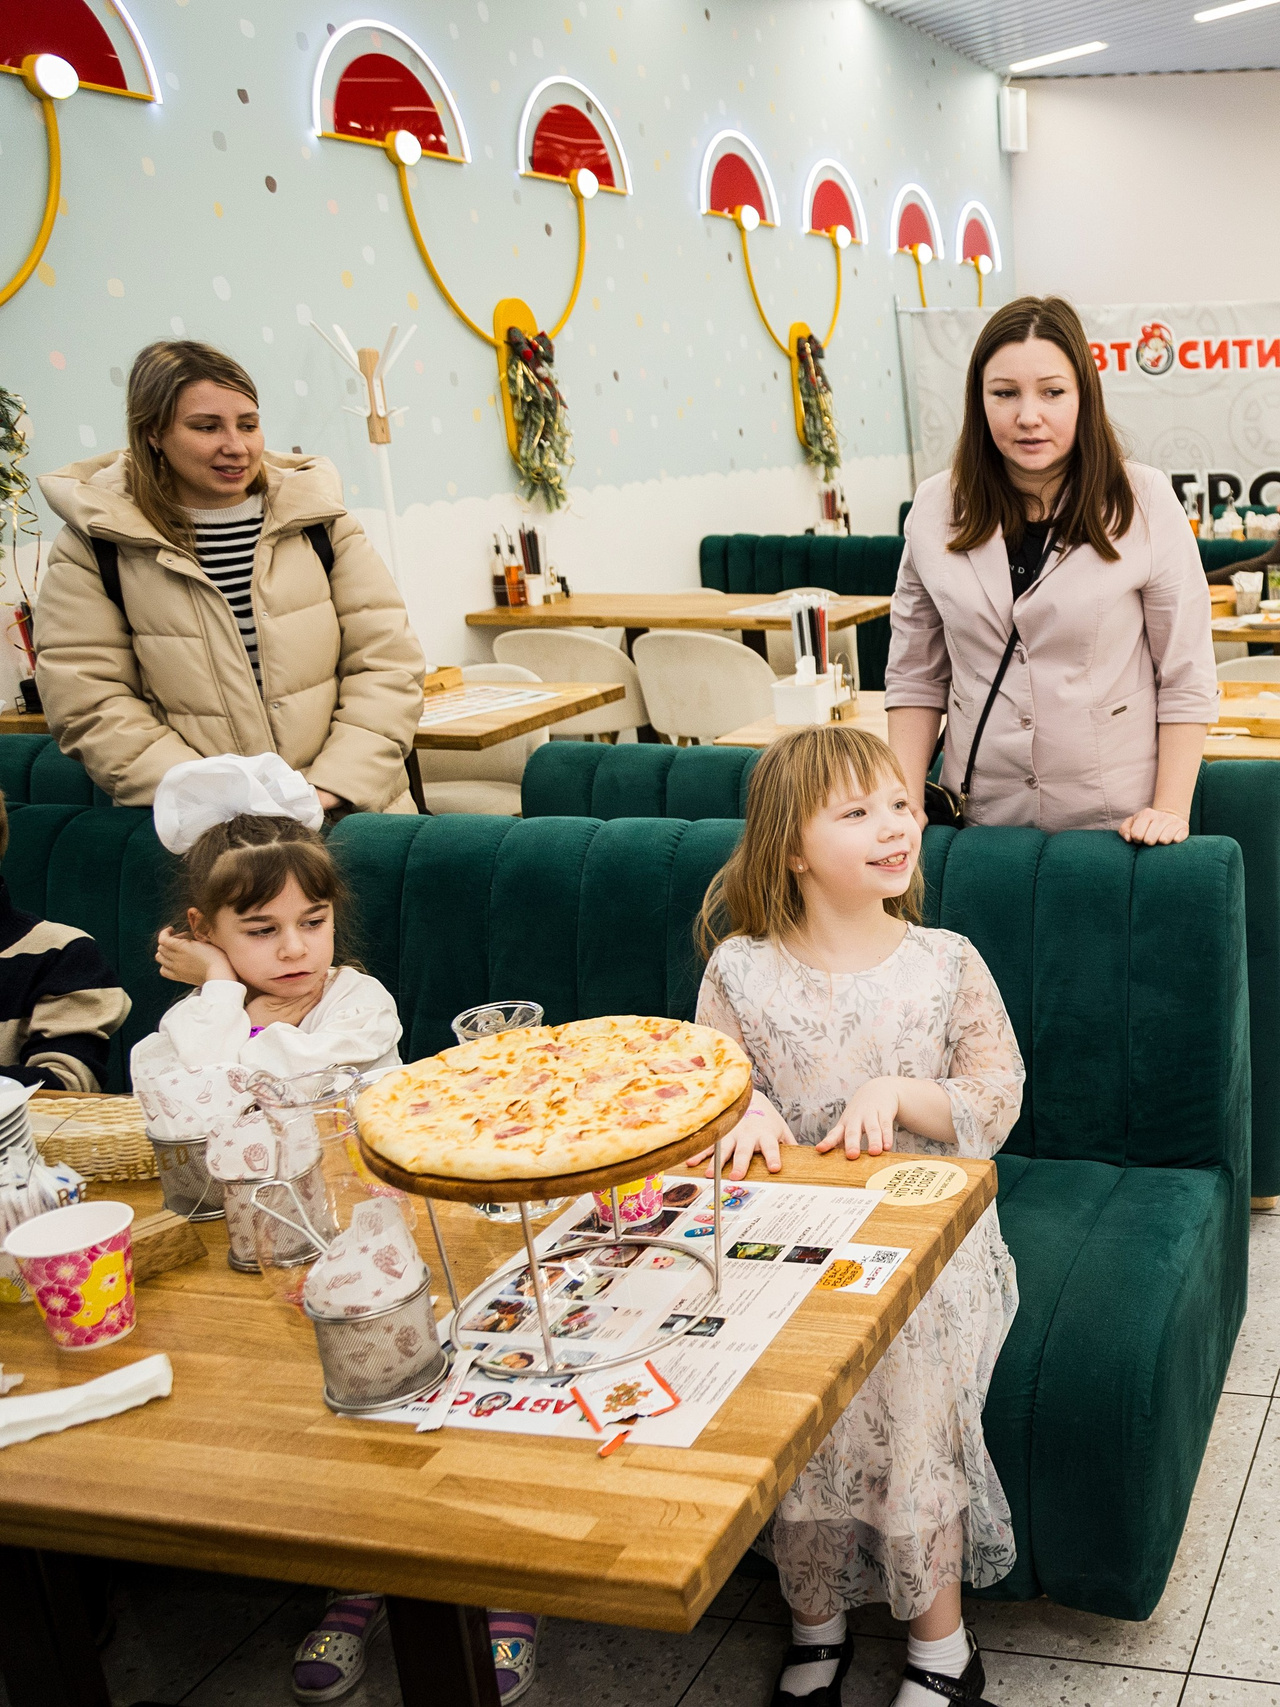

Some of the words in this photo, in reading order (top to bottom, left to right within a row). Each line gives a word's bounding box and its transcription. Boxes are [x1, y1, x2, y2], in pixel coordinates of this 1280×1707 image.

[57, 1145, 190, 1208] RESERVED
[893, 1187, 911, 1198] ЧТО
[903, 1166, 927, 1187] УБРАЛИ
[917, 1170, 940, 1188] СОБОЙ
[911, 1188, 926, 1196] ЗА
